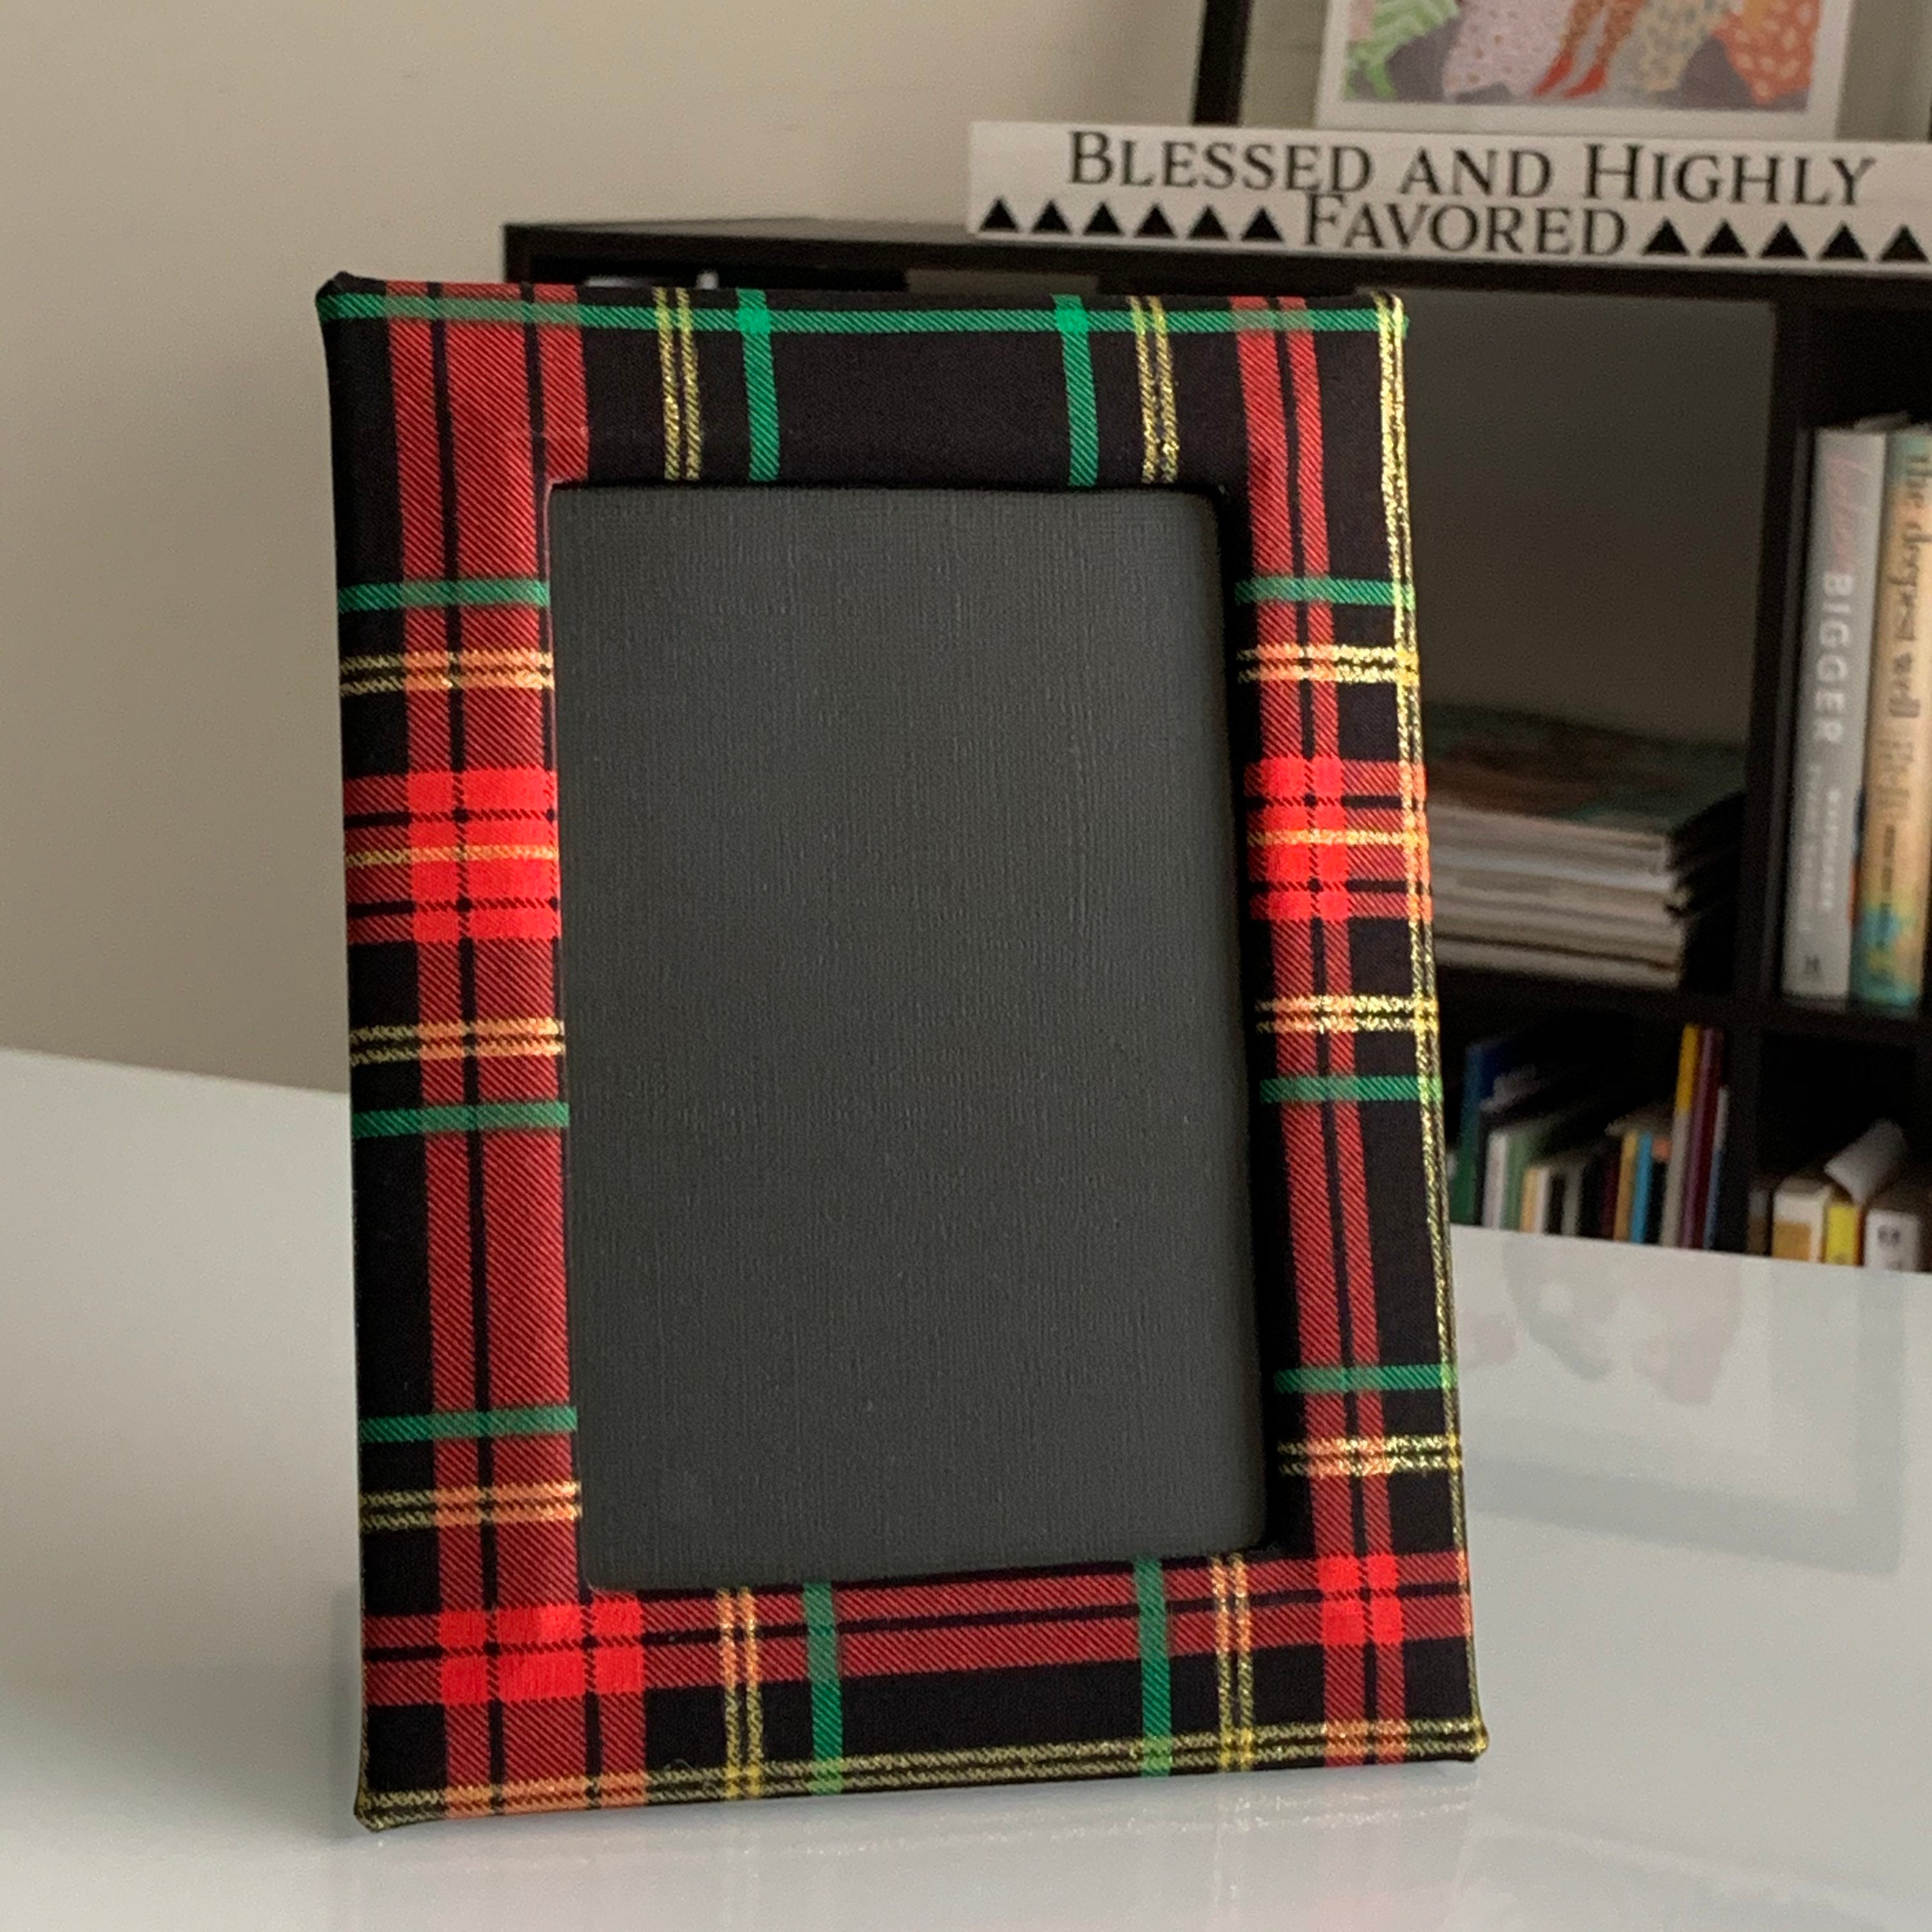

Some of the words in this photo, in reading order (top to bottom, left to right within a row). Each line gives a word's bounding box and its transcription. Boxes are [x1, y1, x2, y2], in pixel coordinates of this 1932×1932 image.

[1070, 130, 1374, 193] BLESSED
[1397, 147, 1553, 198] AND
[1584, 143, 1877, 206] HIGHLY
[1304, 192, 1628, 256] FAVORED
[1813, 572, 1855, 742] BIGGER
